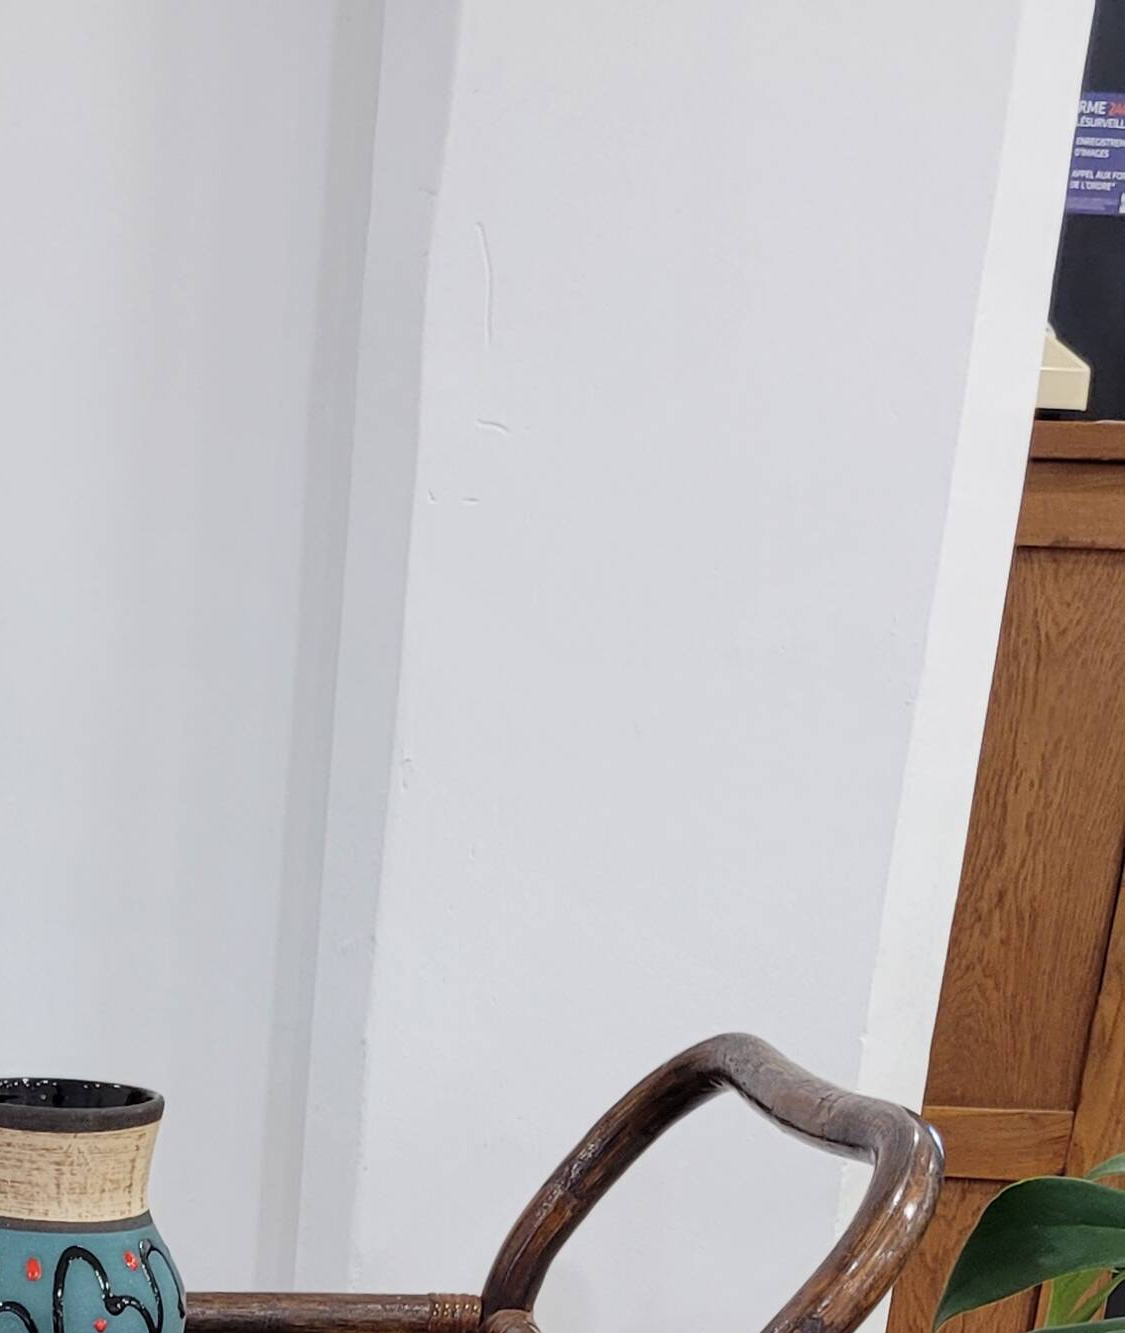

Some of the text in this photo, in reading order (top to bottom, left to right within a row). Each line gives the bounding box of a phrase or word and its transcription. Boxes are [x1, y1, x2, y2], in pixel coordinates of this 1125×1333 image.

[1077, 116, 1125, 129] ÉSURVEILL
[1071, 169, 1094, 180] APPEL
[1095, 170, 1111, 180] AUX
